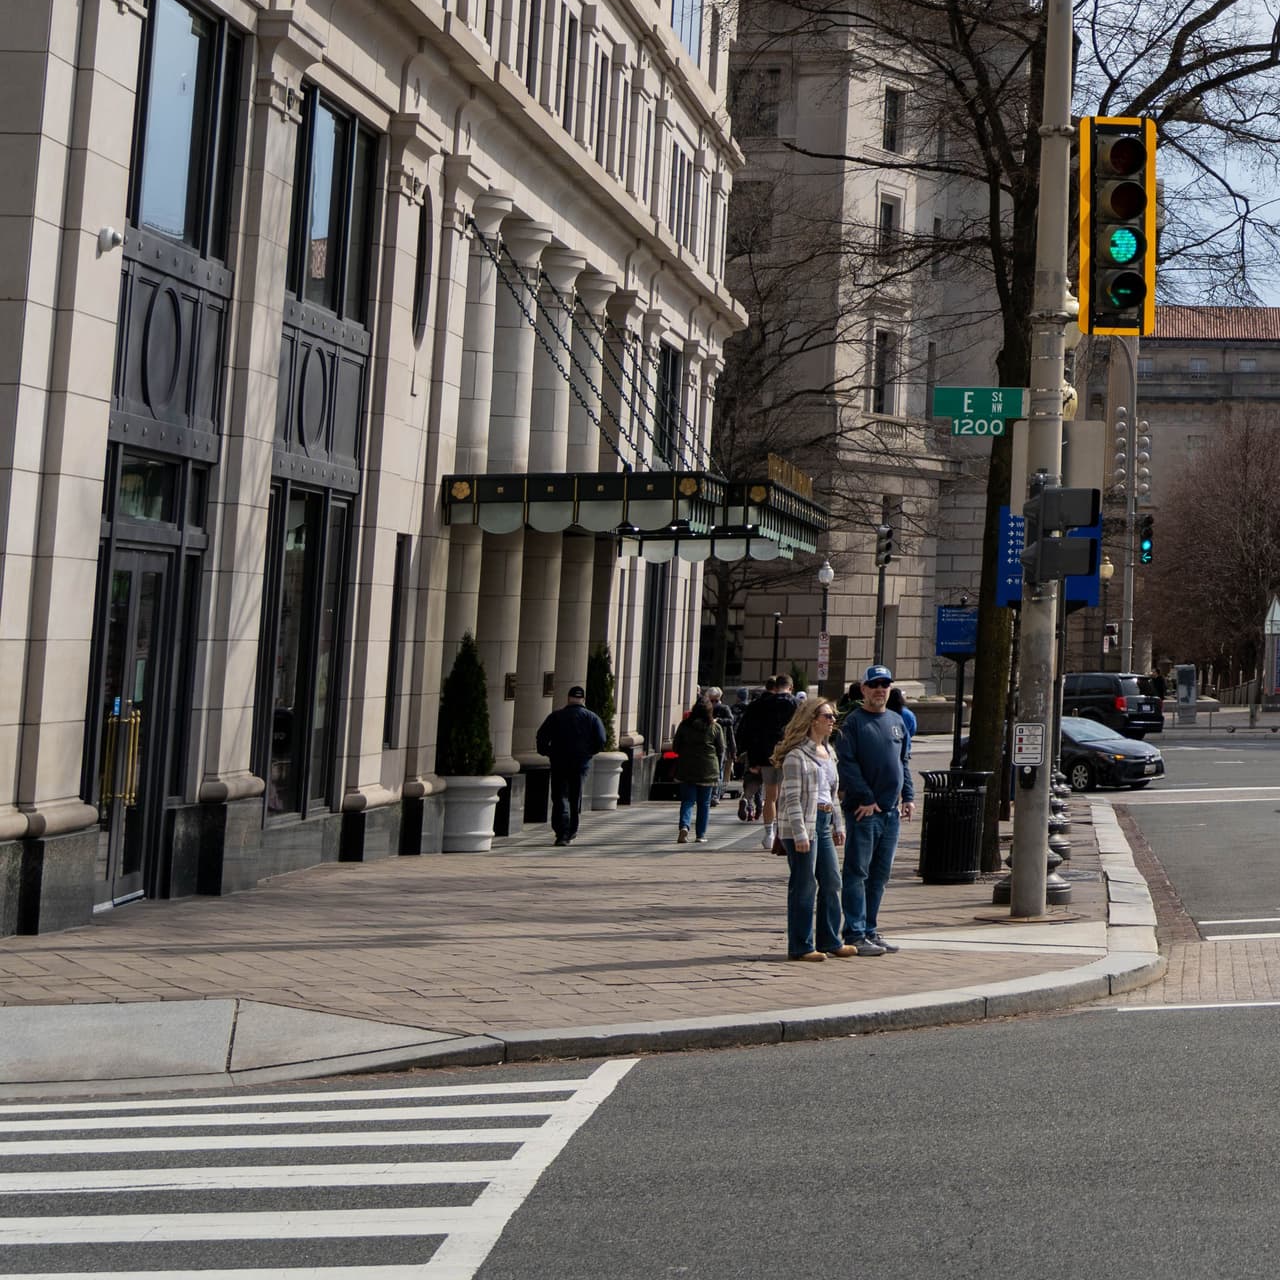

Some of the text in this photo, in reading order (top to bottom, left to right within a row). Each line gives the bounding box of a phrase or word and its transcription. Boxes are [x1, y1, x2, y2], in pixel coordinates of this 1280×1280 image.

[963, 391, 1003, 413] E St
[991, 403, 1003, 413] NW
[953, 419, 1004, 436] 1200
